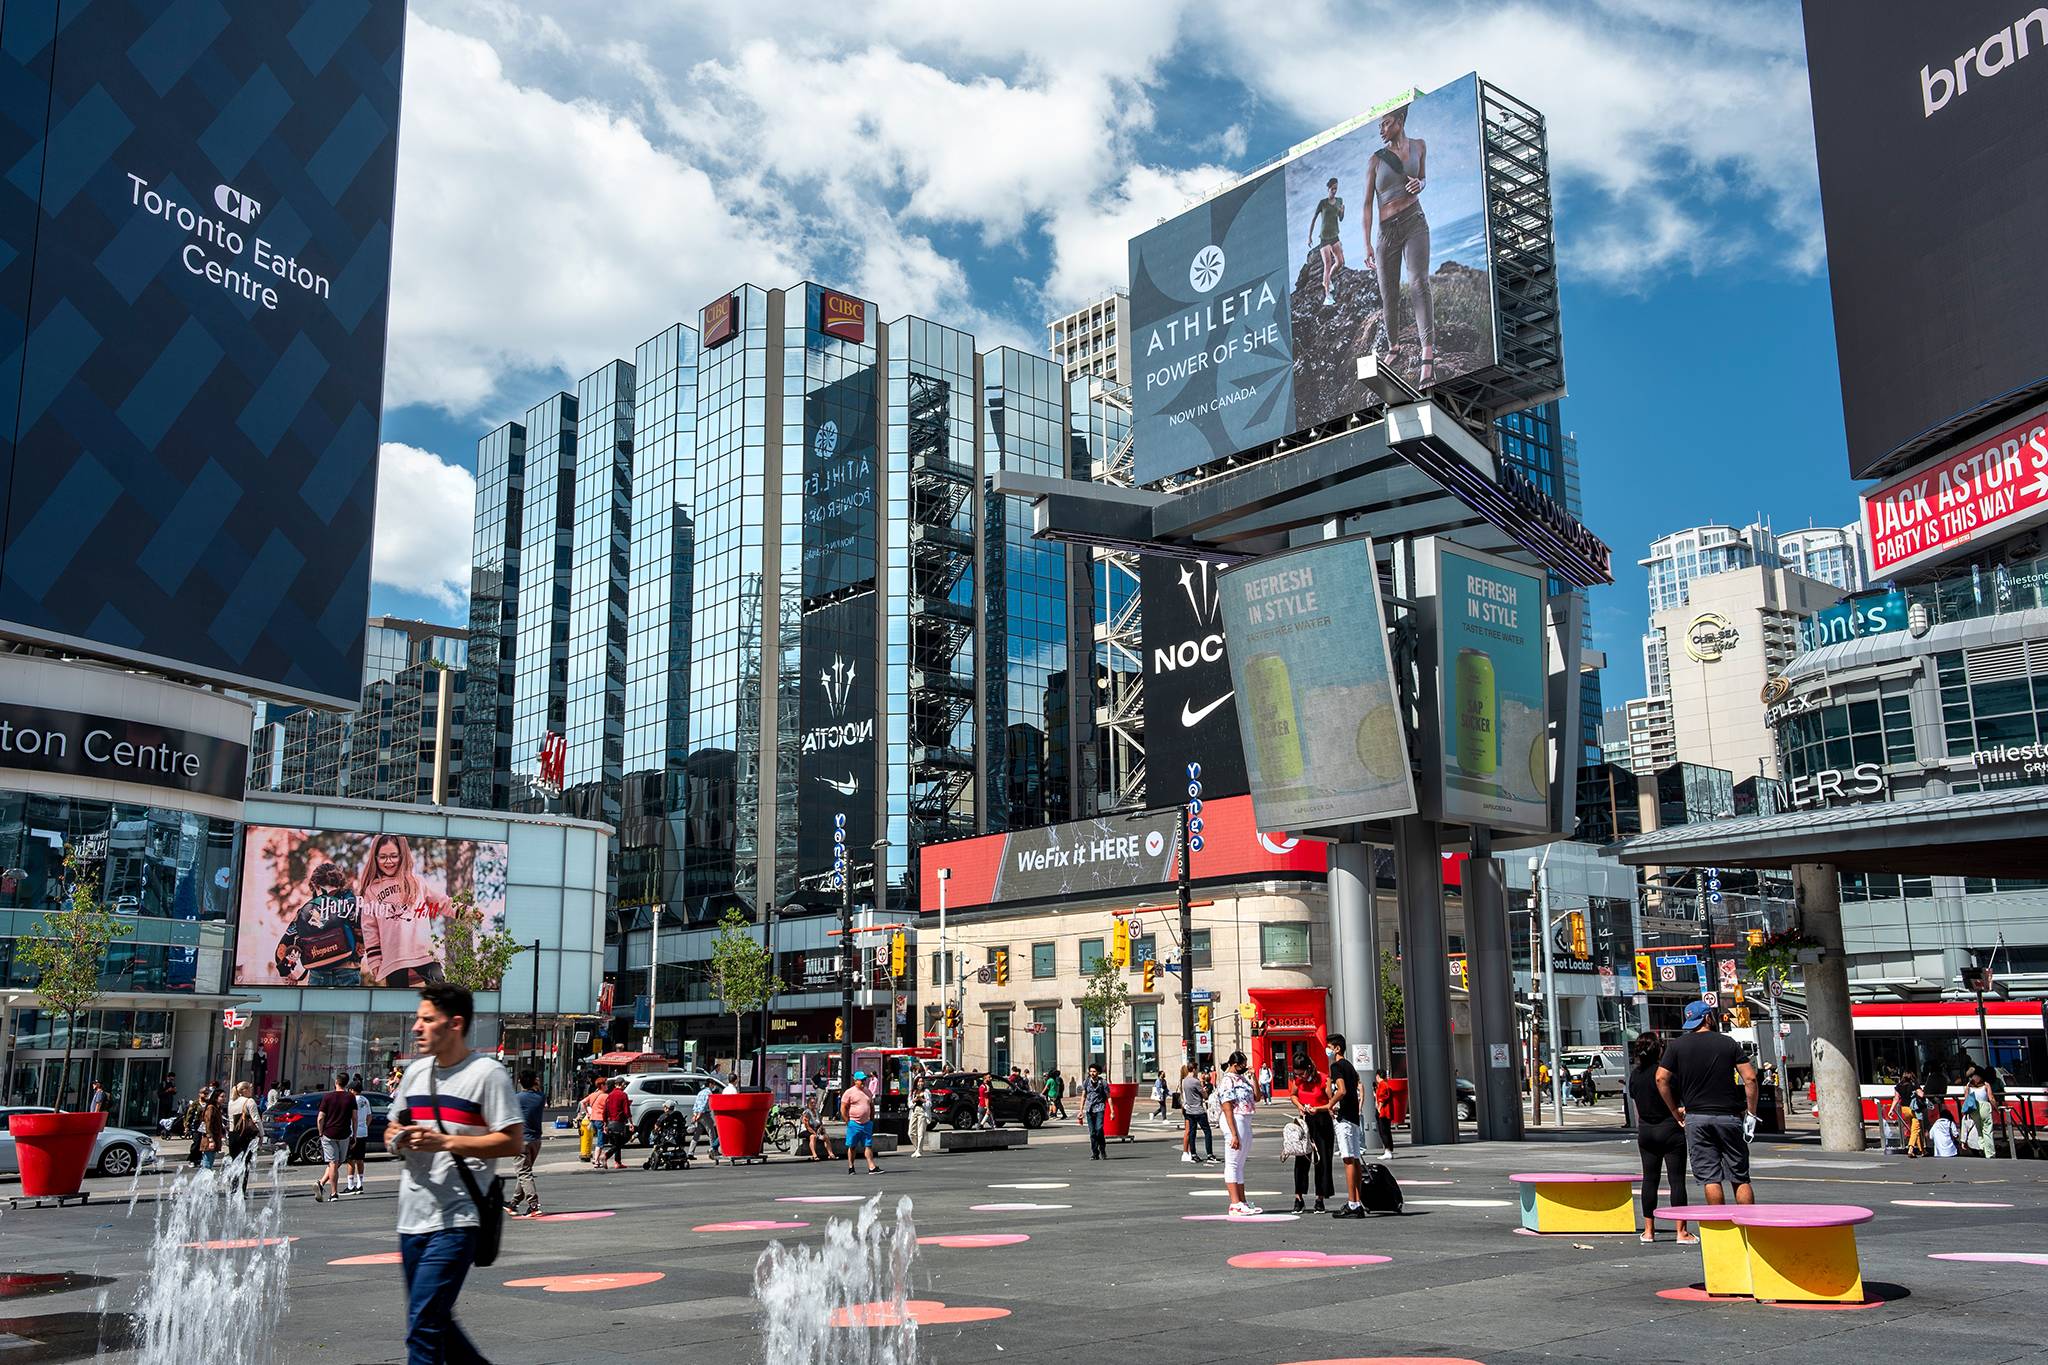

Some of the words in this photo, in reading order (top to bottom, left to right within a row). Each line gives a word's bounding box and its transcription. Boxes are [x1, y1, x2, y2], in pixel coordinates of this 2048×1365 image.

[214, 184, 261, 224] CF
[127, 172, 243, 255] Toronto
[255, 237, 330, 299] Eaton
[182, 244, 279, 310] Centre
[705, 299, 729, 324] CIBC
[828, 296, 863, 319] CIBC
[1147, 281, 1277, 356] ATHLETA
[1146, 355, 1209, 391] POWER
[1213, 338, 1238, 364] OF
[1243, 322, 1279, 353] SHE
[1169, 408, 1196, 427] NOW
[1197, 404, 1208, 416] IN
[1210, 385, 1257, 411] CANADA
[1875, 479, 1932, 540] JACK
[1939, 425, 2048, 513] ASTOR'S
[1877, 527, 1922, 565] PARTY
[1924, 517, 1939, 545] IS
[1941, 503, 1977, 538] THIS
[1976, 484, 2016, 521] WAY
[1245, 567, 1313, 602] REFRESH
[1467, 574, 1517, 606] REFRESH
[1248, 606, 1262, 625] IN
[1265, 591, 1318, 622] STYLE
[1295, 615, 1333, 632] WATER
[1468, 598, 1479, 618] IN
[1482, 602, 1518, 629] STYLE
[1154, 632, 1226, 674] NOC
[1462, 622, 1485, 635] TASTE
[1485, 627, 1502, 640] TREE
[1502, 633, 1525, 646] WATER
[0, 720, 67, 758] ton
[84, 729, 200, 777] Centre
[1187, 762, 1203, 852] Yonge
[1776, 763, 1884, 812] NERS
[834, 813, 846, 889] Yonge
[1017, 844, 1068, 873] WeFix
[1072, 843, 1087, 865] it
[1090, 834, 1139, 862] HERE
[1176, 811, 1184, 874] DOWNTOWN
[319, 897, 355, 920] Harry
[355, 895, 391, 921] Potter
[414, 902, 439, 920] H&M
[1696, 873, 1706, 921] DOWNTOWN
[806, 957, 829, 975] MUJI
[1137, 948, 1153, 962] 5G
[1552, 956, 1568, 969] oot
[1568, 957, 1593, 970] Locker
[772, 1019, 786, 1030] MUJI
[1279, 1017, 1315, 1026] ROGERS
